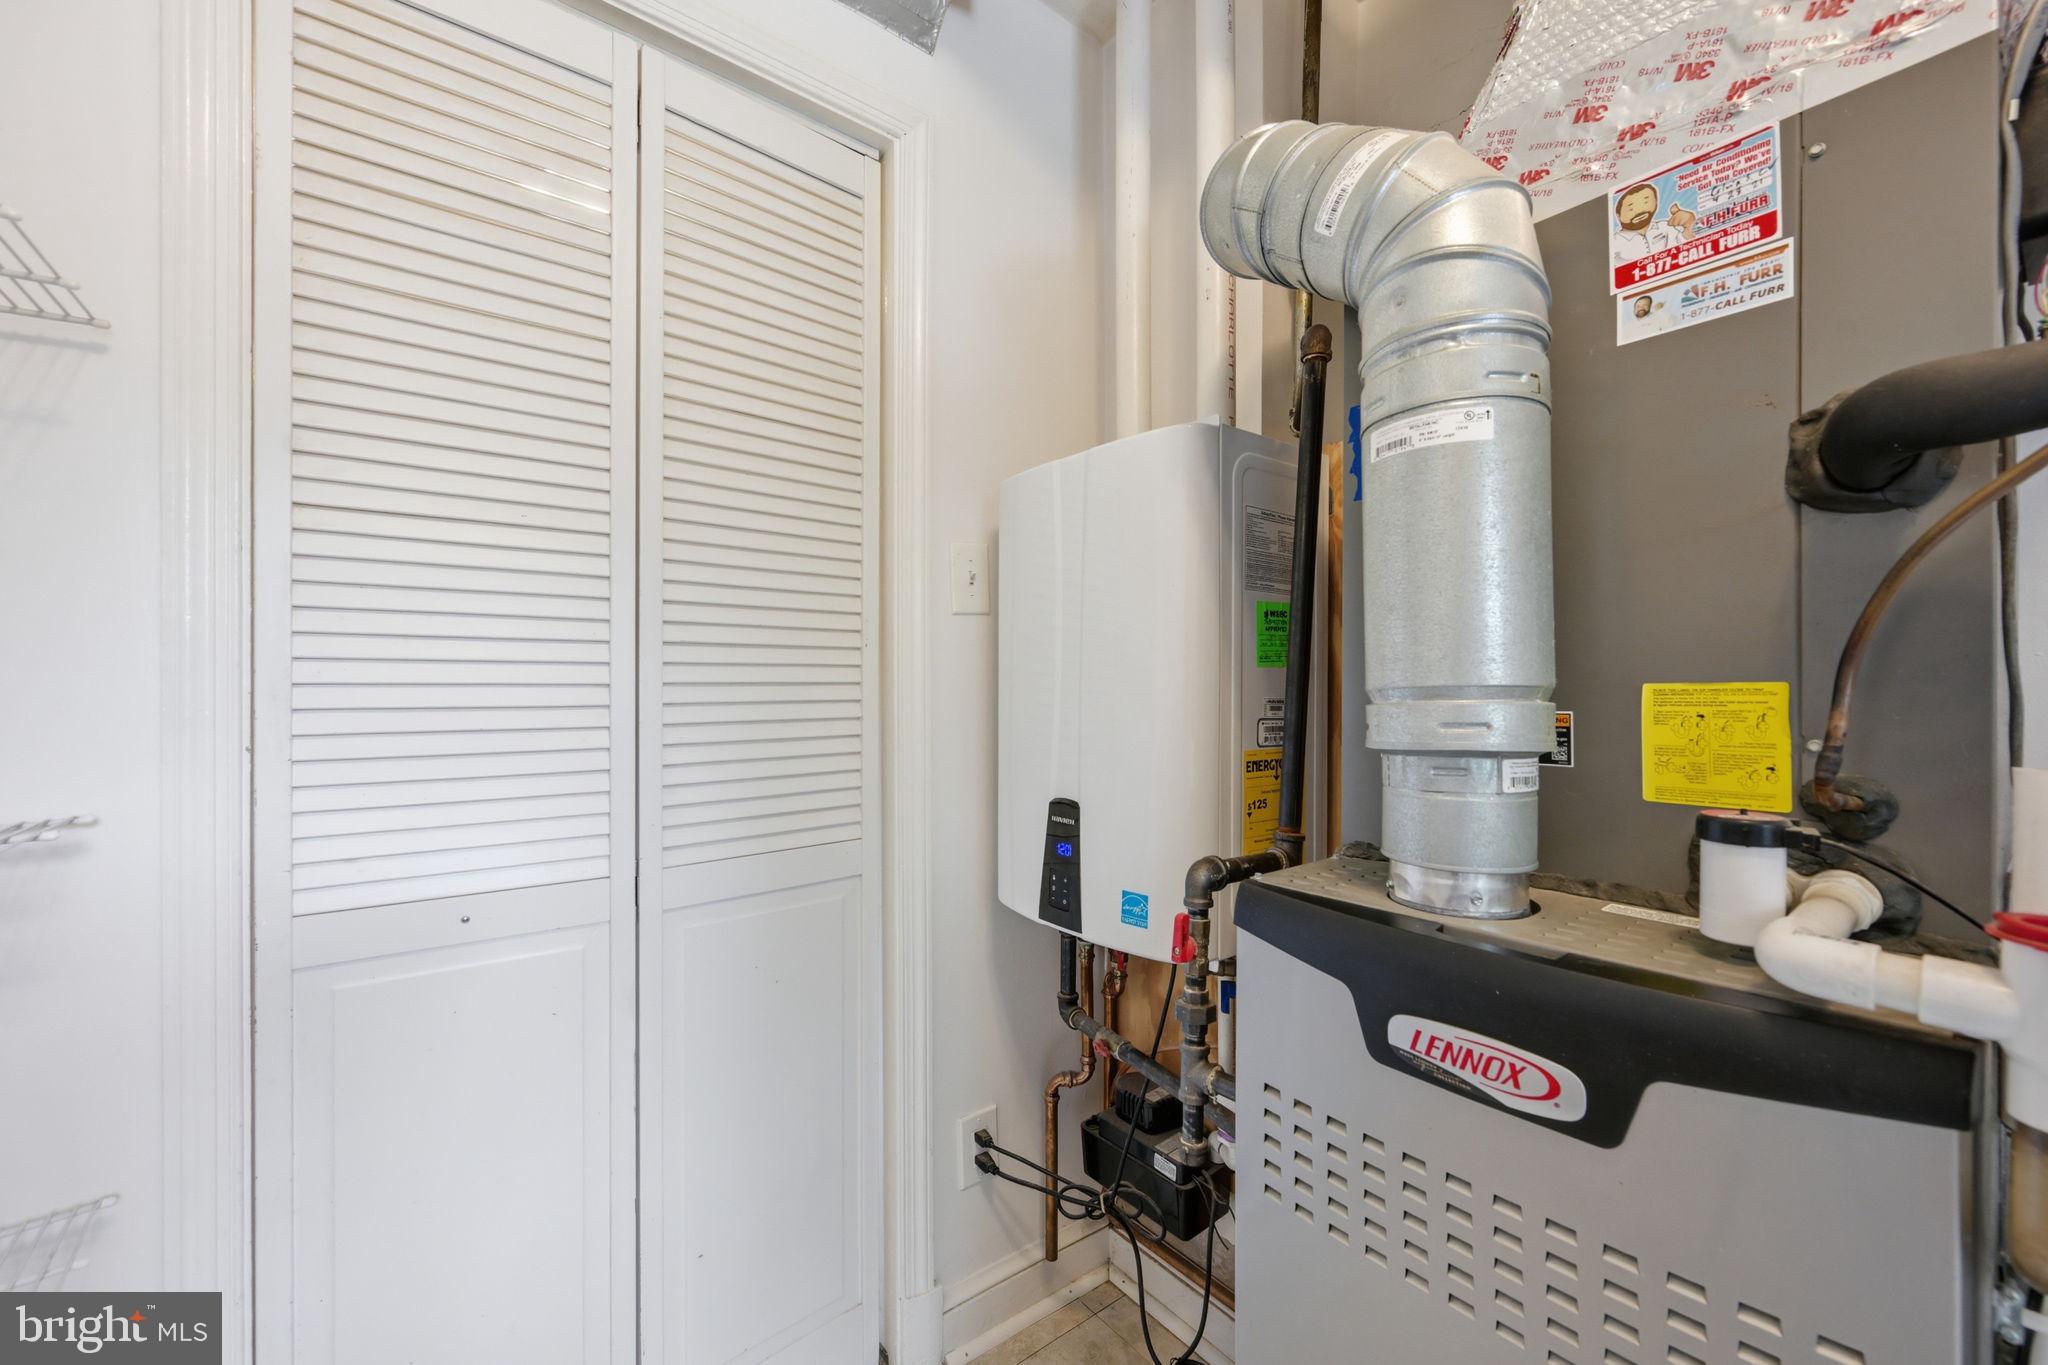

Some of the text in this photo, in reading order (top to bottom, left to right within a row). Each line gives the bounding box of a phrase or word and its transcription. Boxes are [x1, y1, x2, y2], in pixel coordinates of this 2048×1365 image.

[1673, 60, 1715, 83] 3M
[1572, 104, 1608, 125] 3M
[1716, 139, 1771, 167] Conditioning
[1677, 174, 1708, 191] Service
[1711, 159, 1742, 177] Today?
[1698, 180, 1712, 191] Got
[1715, 175, 1730, 185] You
[1632, 243, 1714, 281] 1-877-CALL
[1718, 225, 1761, 252] FURR
[1637, 220, 1754, 267] Call For A Technician Today
[1701, 281, 1731, 298] F.H.
[1739, 263, 1783, 285] FURR
[1681, 295, 1746, 320] 1-877-CALL
[1750, 284, 1785, 300] FURR
[1409, 1029, 1527, 1090] LENNOX
